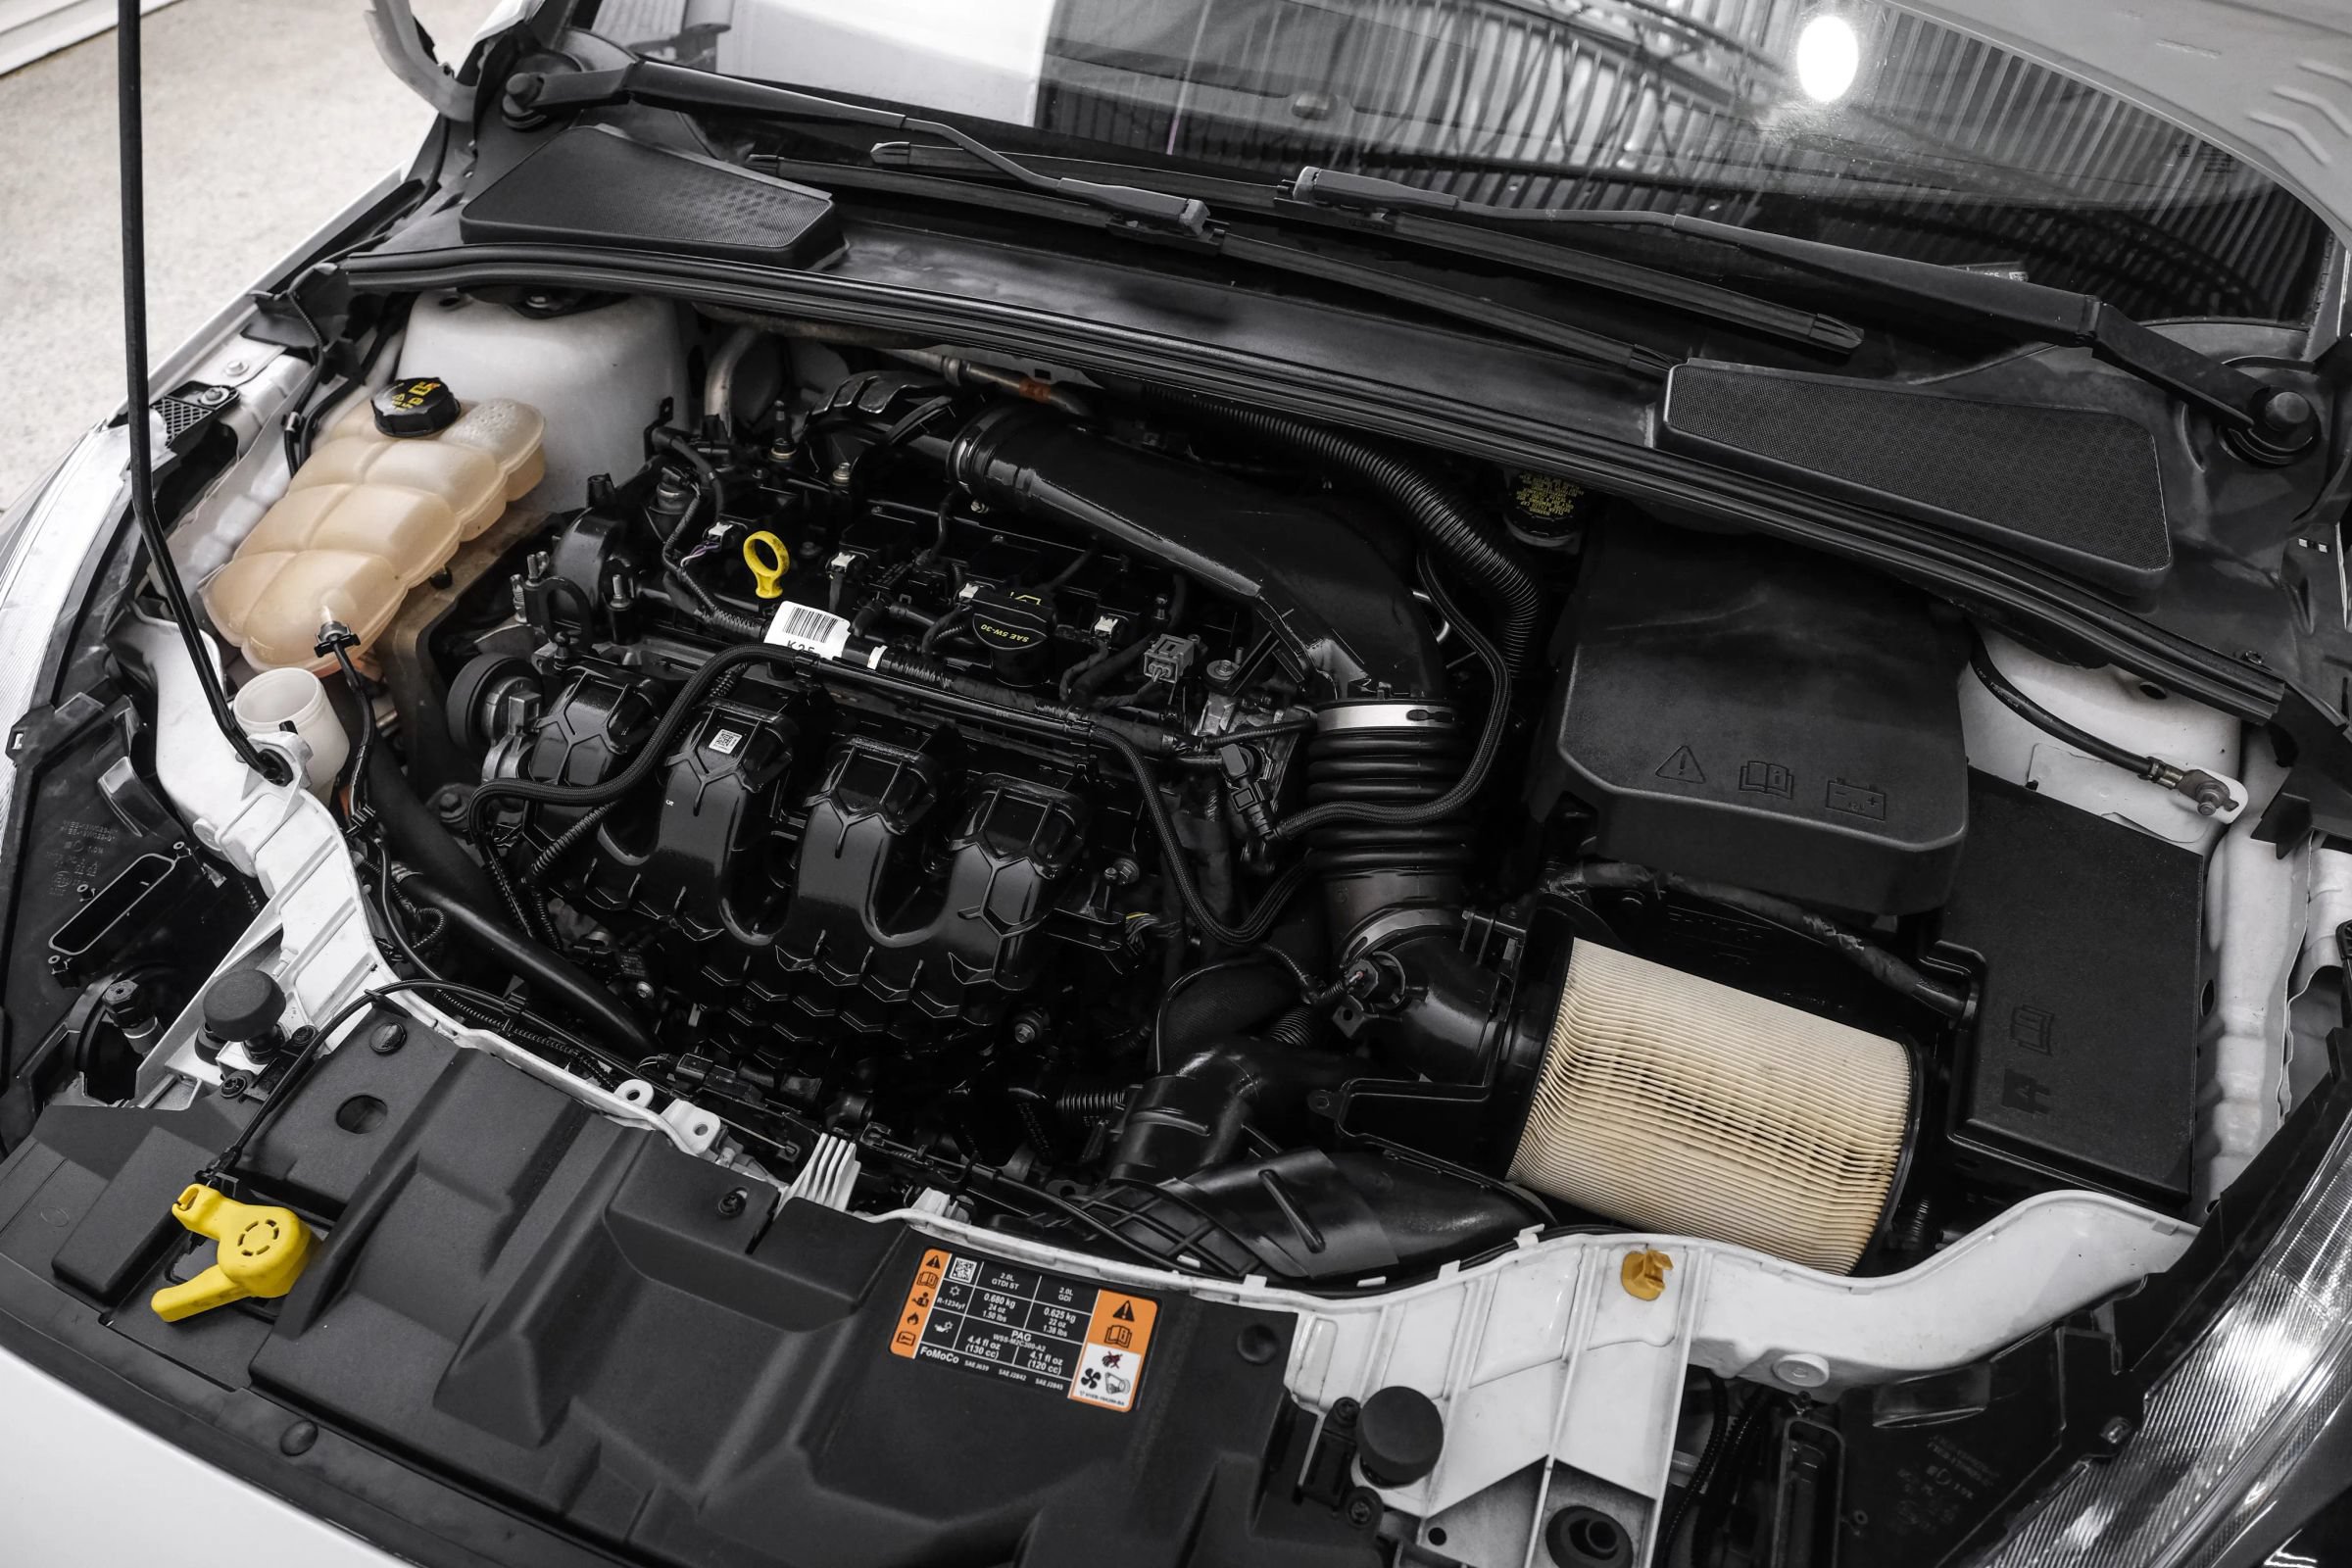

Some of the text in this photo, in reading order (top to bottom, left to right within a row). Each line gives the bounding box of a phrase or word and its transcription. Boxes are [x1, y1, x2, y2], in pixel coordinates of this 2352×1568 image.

[980, 623, 1030, 643] SAE 5W-30
[991, 1278, 1008, 1288] GTDI
[1001, 1272, 1014, 1282] 2.0L
[1059, 1287, 1073, 1296] 2.0L
[937, 1297, 965, 1309] R-1234yf
[983, 1293, 1016, 1309] 0.680 kg
[996, 1313, 1007, 1322] lbs
[1044, 1307, 1076, 1324] 0.625 kg
[1011, 1330, 1032, 1342] PAG
[1056, 1328, 1067, 1337] lbs
[967, 1335, 981, 1346] 4.4
[982, 1338, 989, 1347] fl
[920, 1346, 959, 1364] FoMoCo
[964, 1344, 1000, 1360] (130 cc)
[964, 1359, 975, 1368] SAE
[1029, 1351, 1063, 1366] 4.1 fl oz
[999, 1368, 1009, 1377] SAE
[1027, 1359, 1062, 1376] (120 cc)
